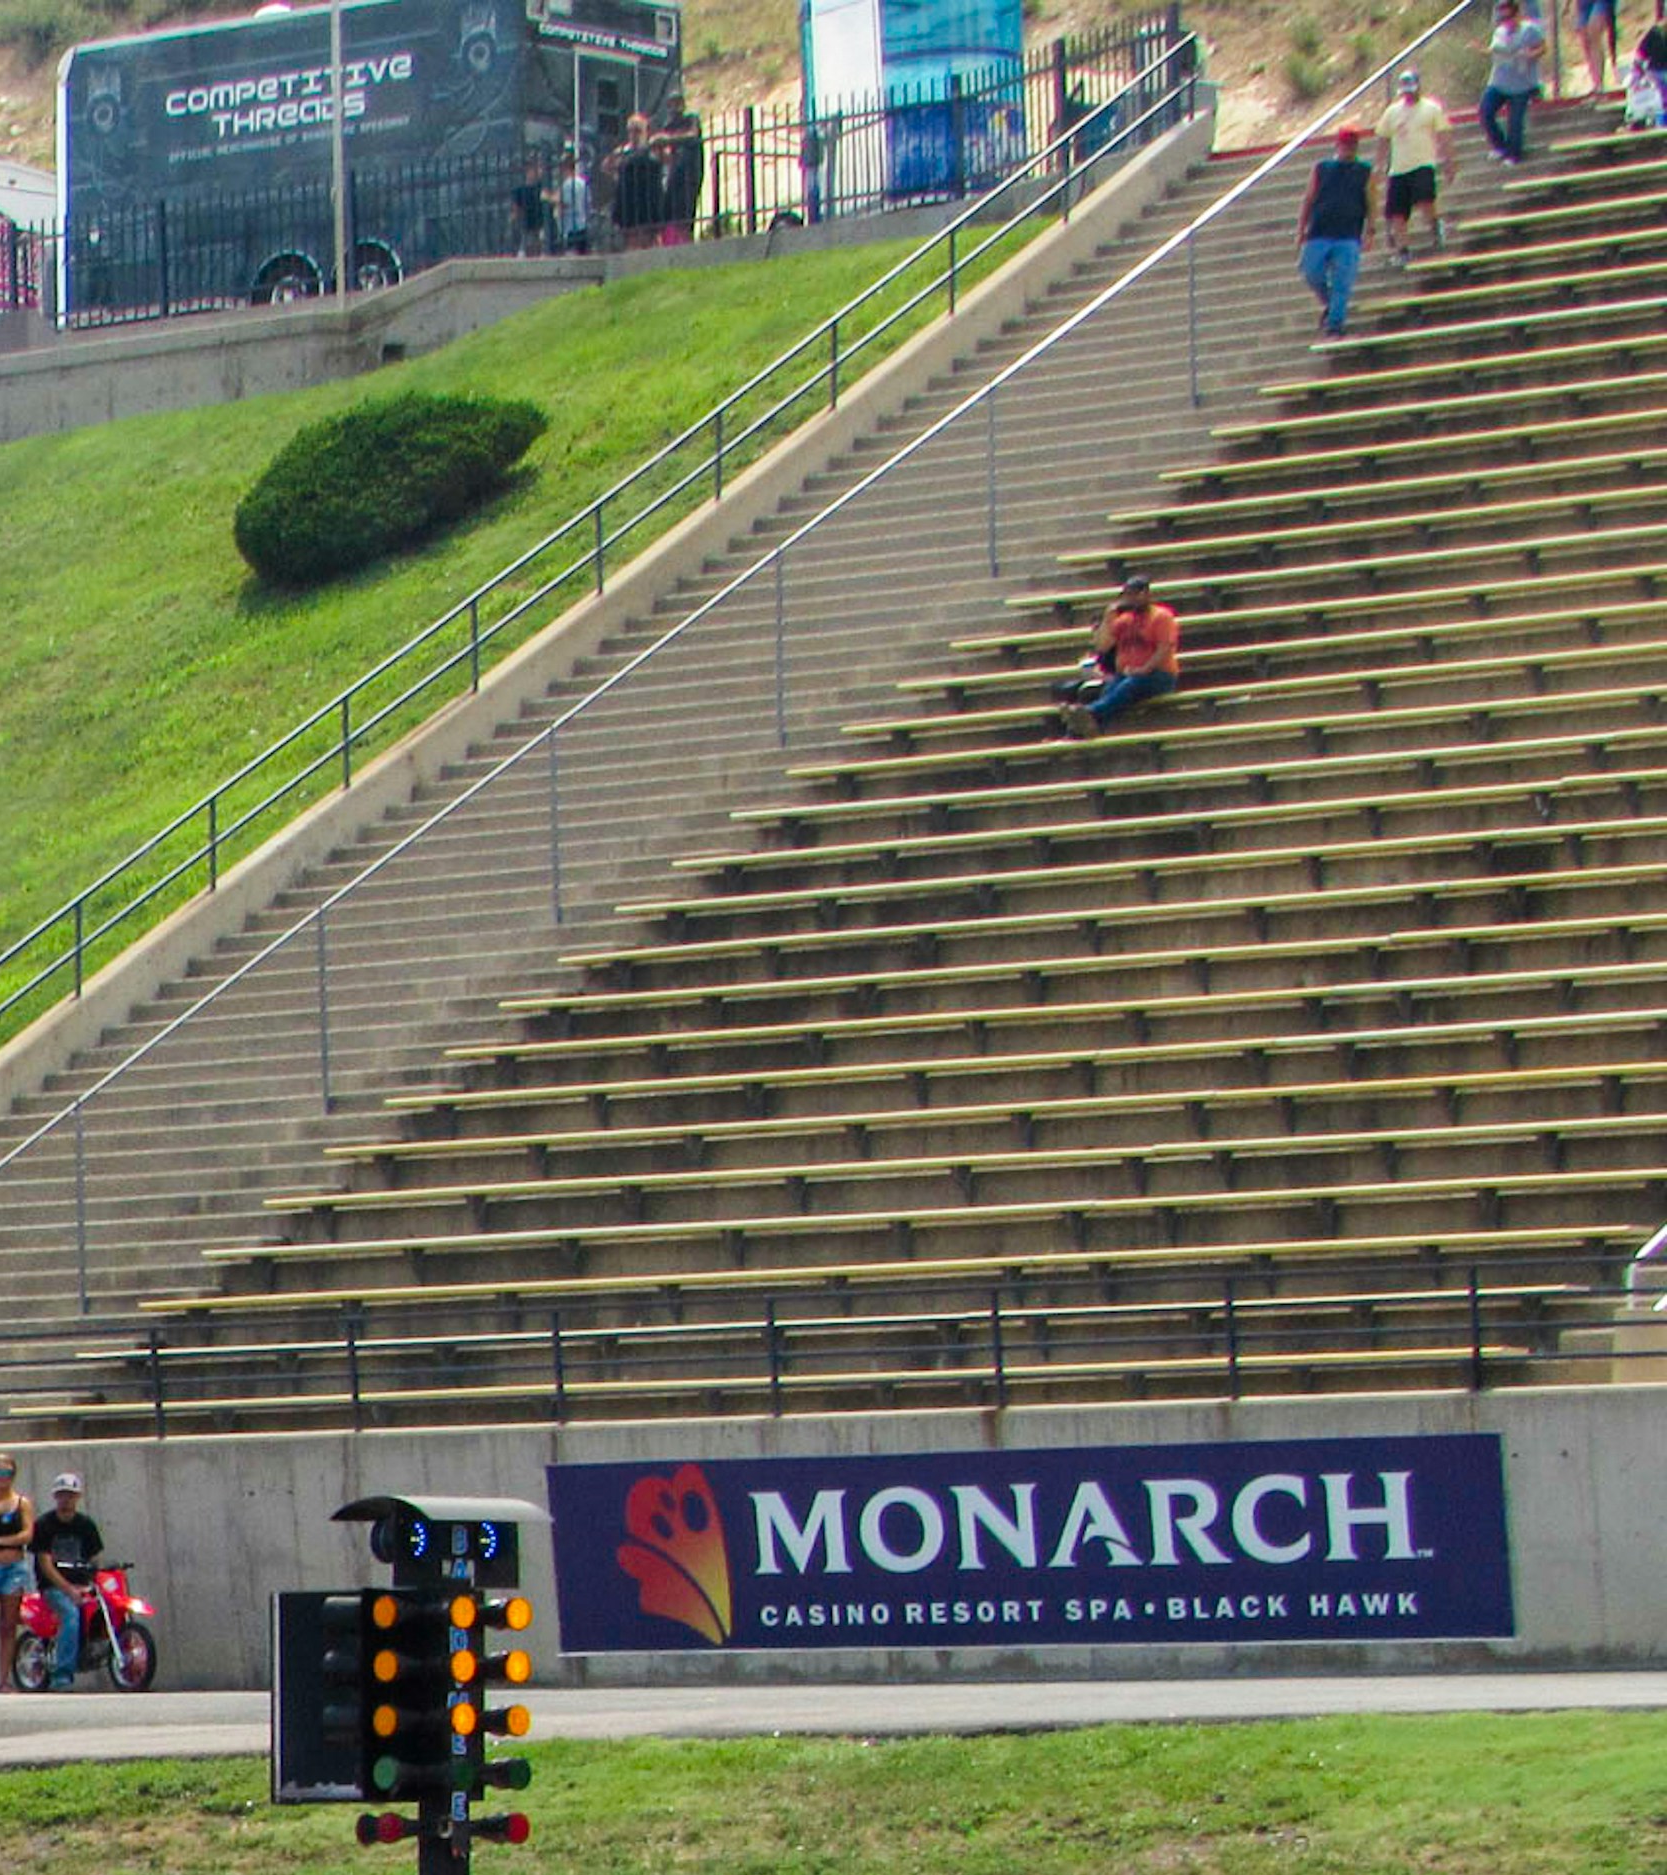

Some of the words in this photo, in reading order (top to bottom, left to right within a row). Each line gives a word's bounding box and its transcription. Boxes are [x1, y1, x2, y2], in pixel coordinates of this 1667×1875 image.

[749, 1471, 1419, 1575] MONARCH
[760, 1604, 891, 1627] CASINO
[904, 1599, 1044, 1625] RESORT
[1064, 1598, 1133, 1621] SPA
[1167, 1594, 1288, 1619] BLACK
[1309, 1591, 1419, 1617] HAWK
